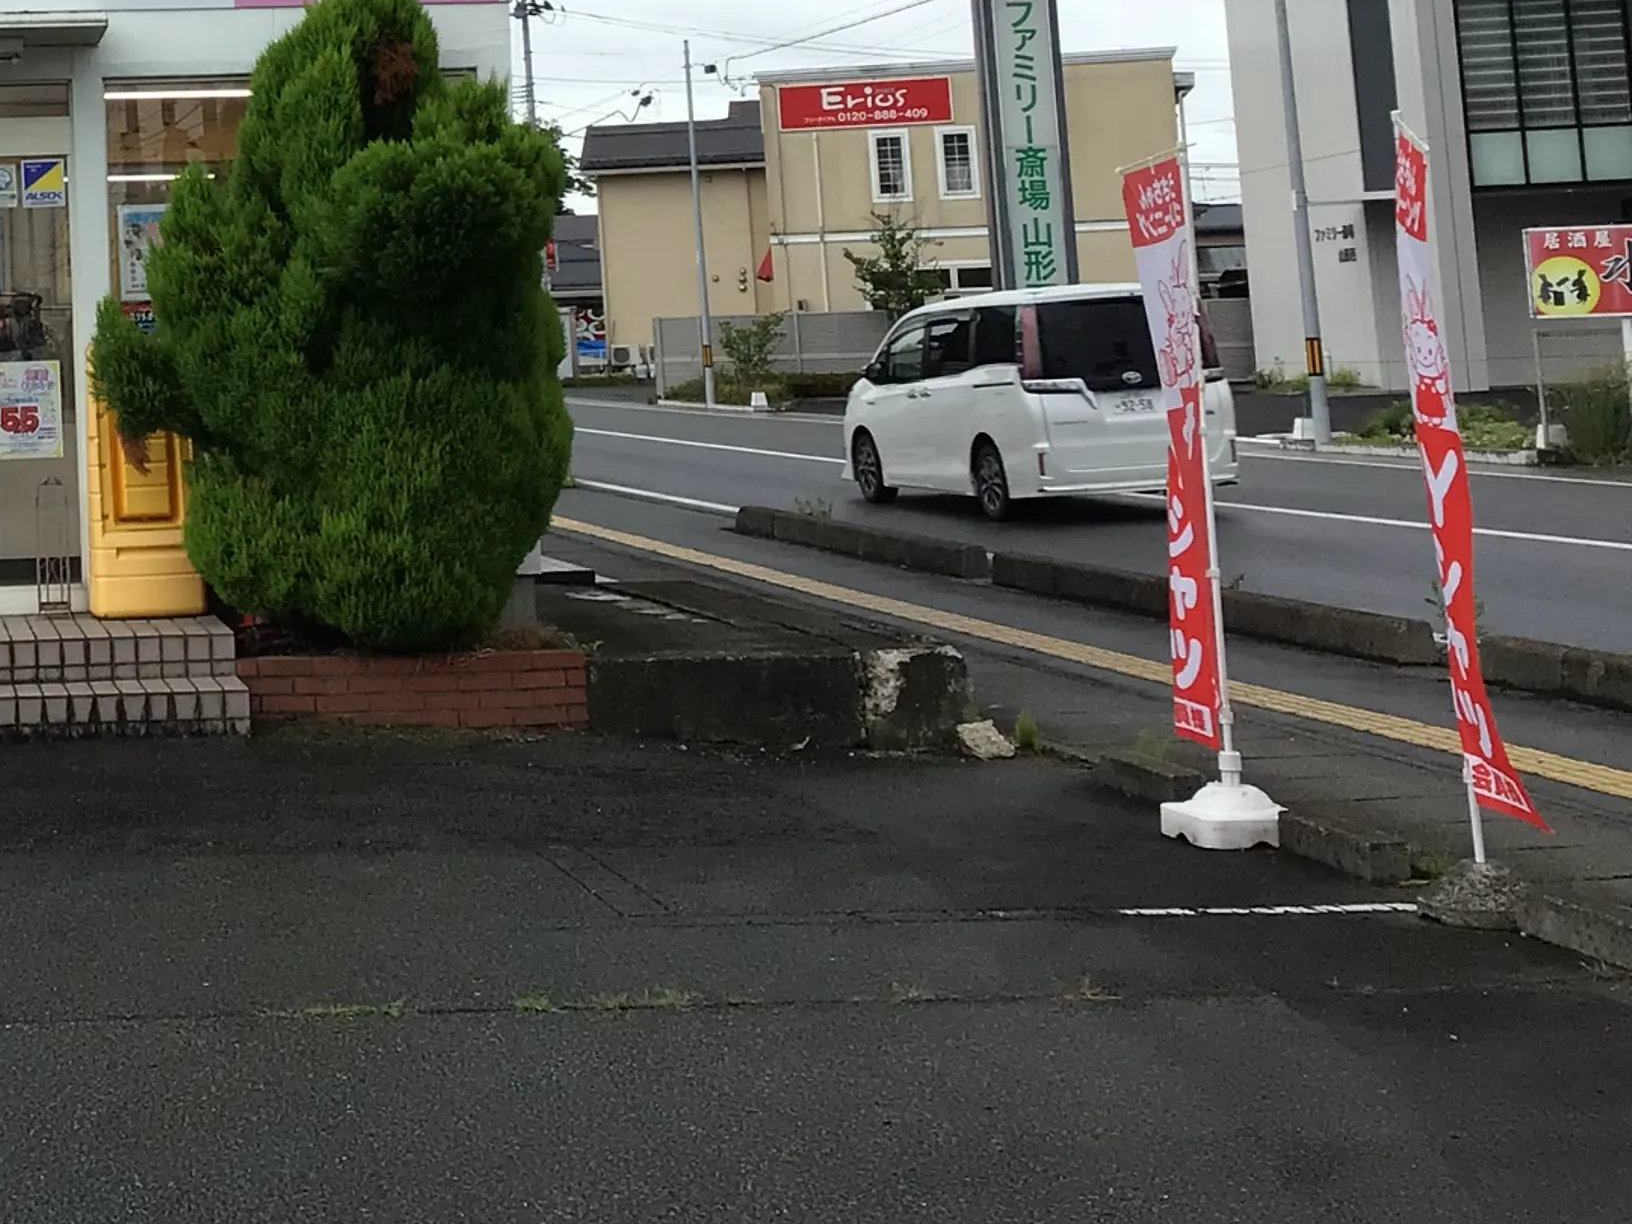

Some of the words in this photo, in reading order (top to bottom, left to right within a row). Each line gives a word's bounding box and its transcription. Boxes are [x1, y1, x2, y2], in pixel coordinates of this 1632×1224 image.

[821, 86, 907, 110] Erios
[838, 108, 928, 122] 0120-888-409
[1543, 230, 1613, 249] 居酒屋
